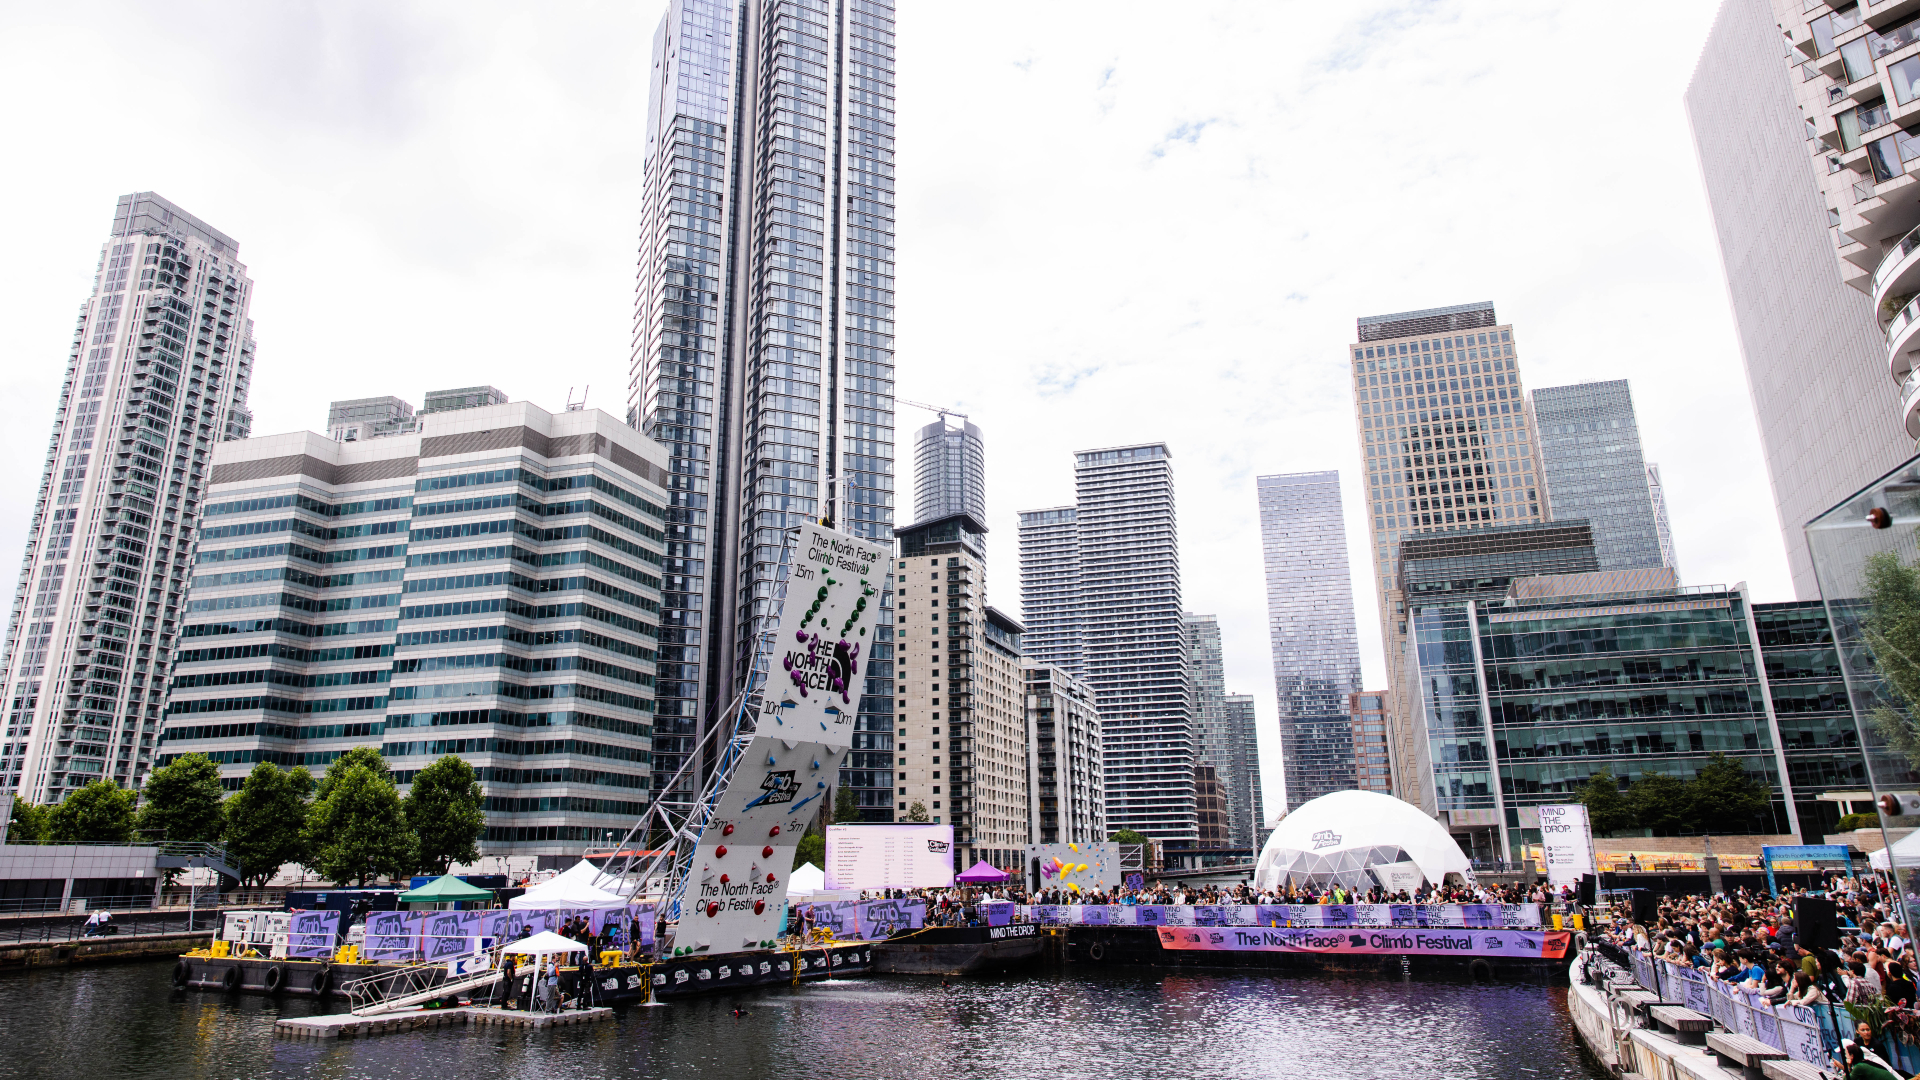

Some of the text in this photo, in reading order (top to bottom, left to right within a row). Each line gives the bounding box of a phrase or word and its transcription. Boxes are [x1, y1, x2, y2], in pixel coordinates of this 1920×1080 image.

[812, 531, 829, 549] The
[830, 538, 855, 557] North
[808, 547, 870, 575] Climb Festival
[794, 563, 815, 581] 15m
[811, 637, 834, 657] HE
[763, 700, 784, 716] 10m
[834, 711, 853, 725] 10m
[1541, 807, 1566, 816] MIND
[709, 817, 729, 830] 5m
[787, 820, 804, 832] 5m
[1542, 816, 1562, 825] THE
[1544, 825, 1572, 833] DROP.
[700, 883, 719, 897] The
[721, 882, 749, 896] North
[695, 898, 726, 913] Clib
[869, 903, 899, 920] Climb
[376, 917, 401, 935] Climb
[432, 919, 458, 936] Climb
[990, 924, 1036, 939] MIND THE DROP.
[434, 937, 463, 955] Festival
[1235, 931, 1261, 946] The
[1263, 932, 1302, 947] North
[1370, 934, 1413, 949] Climb
[1416, 934, 1473, 950] Festival
